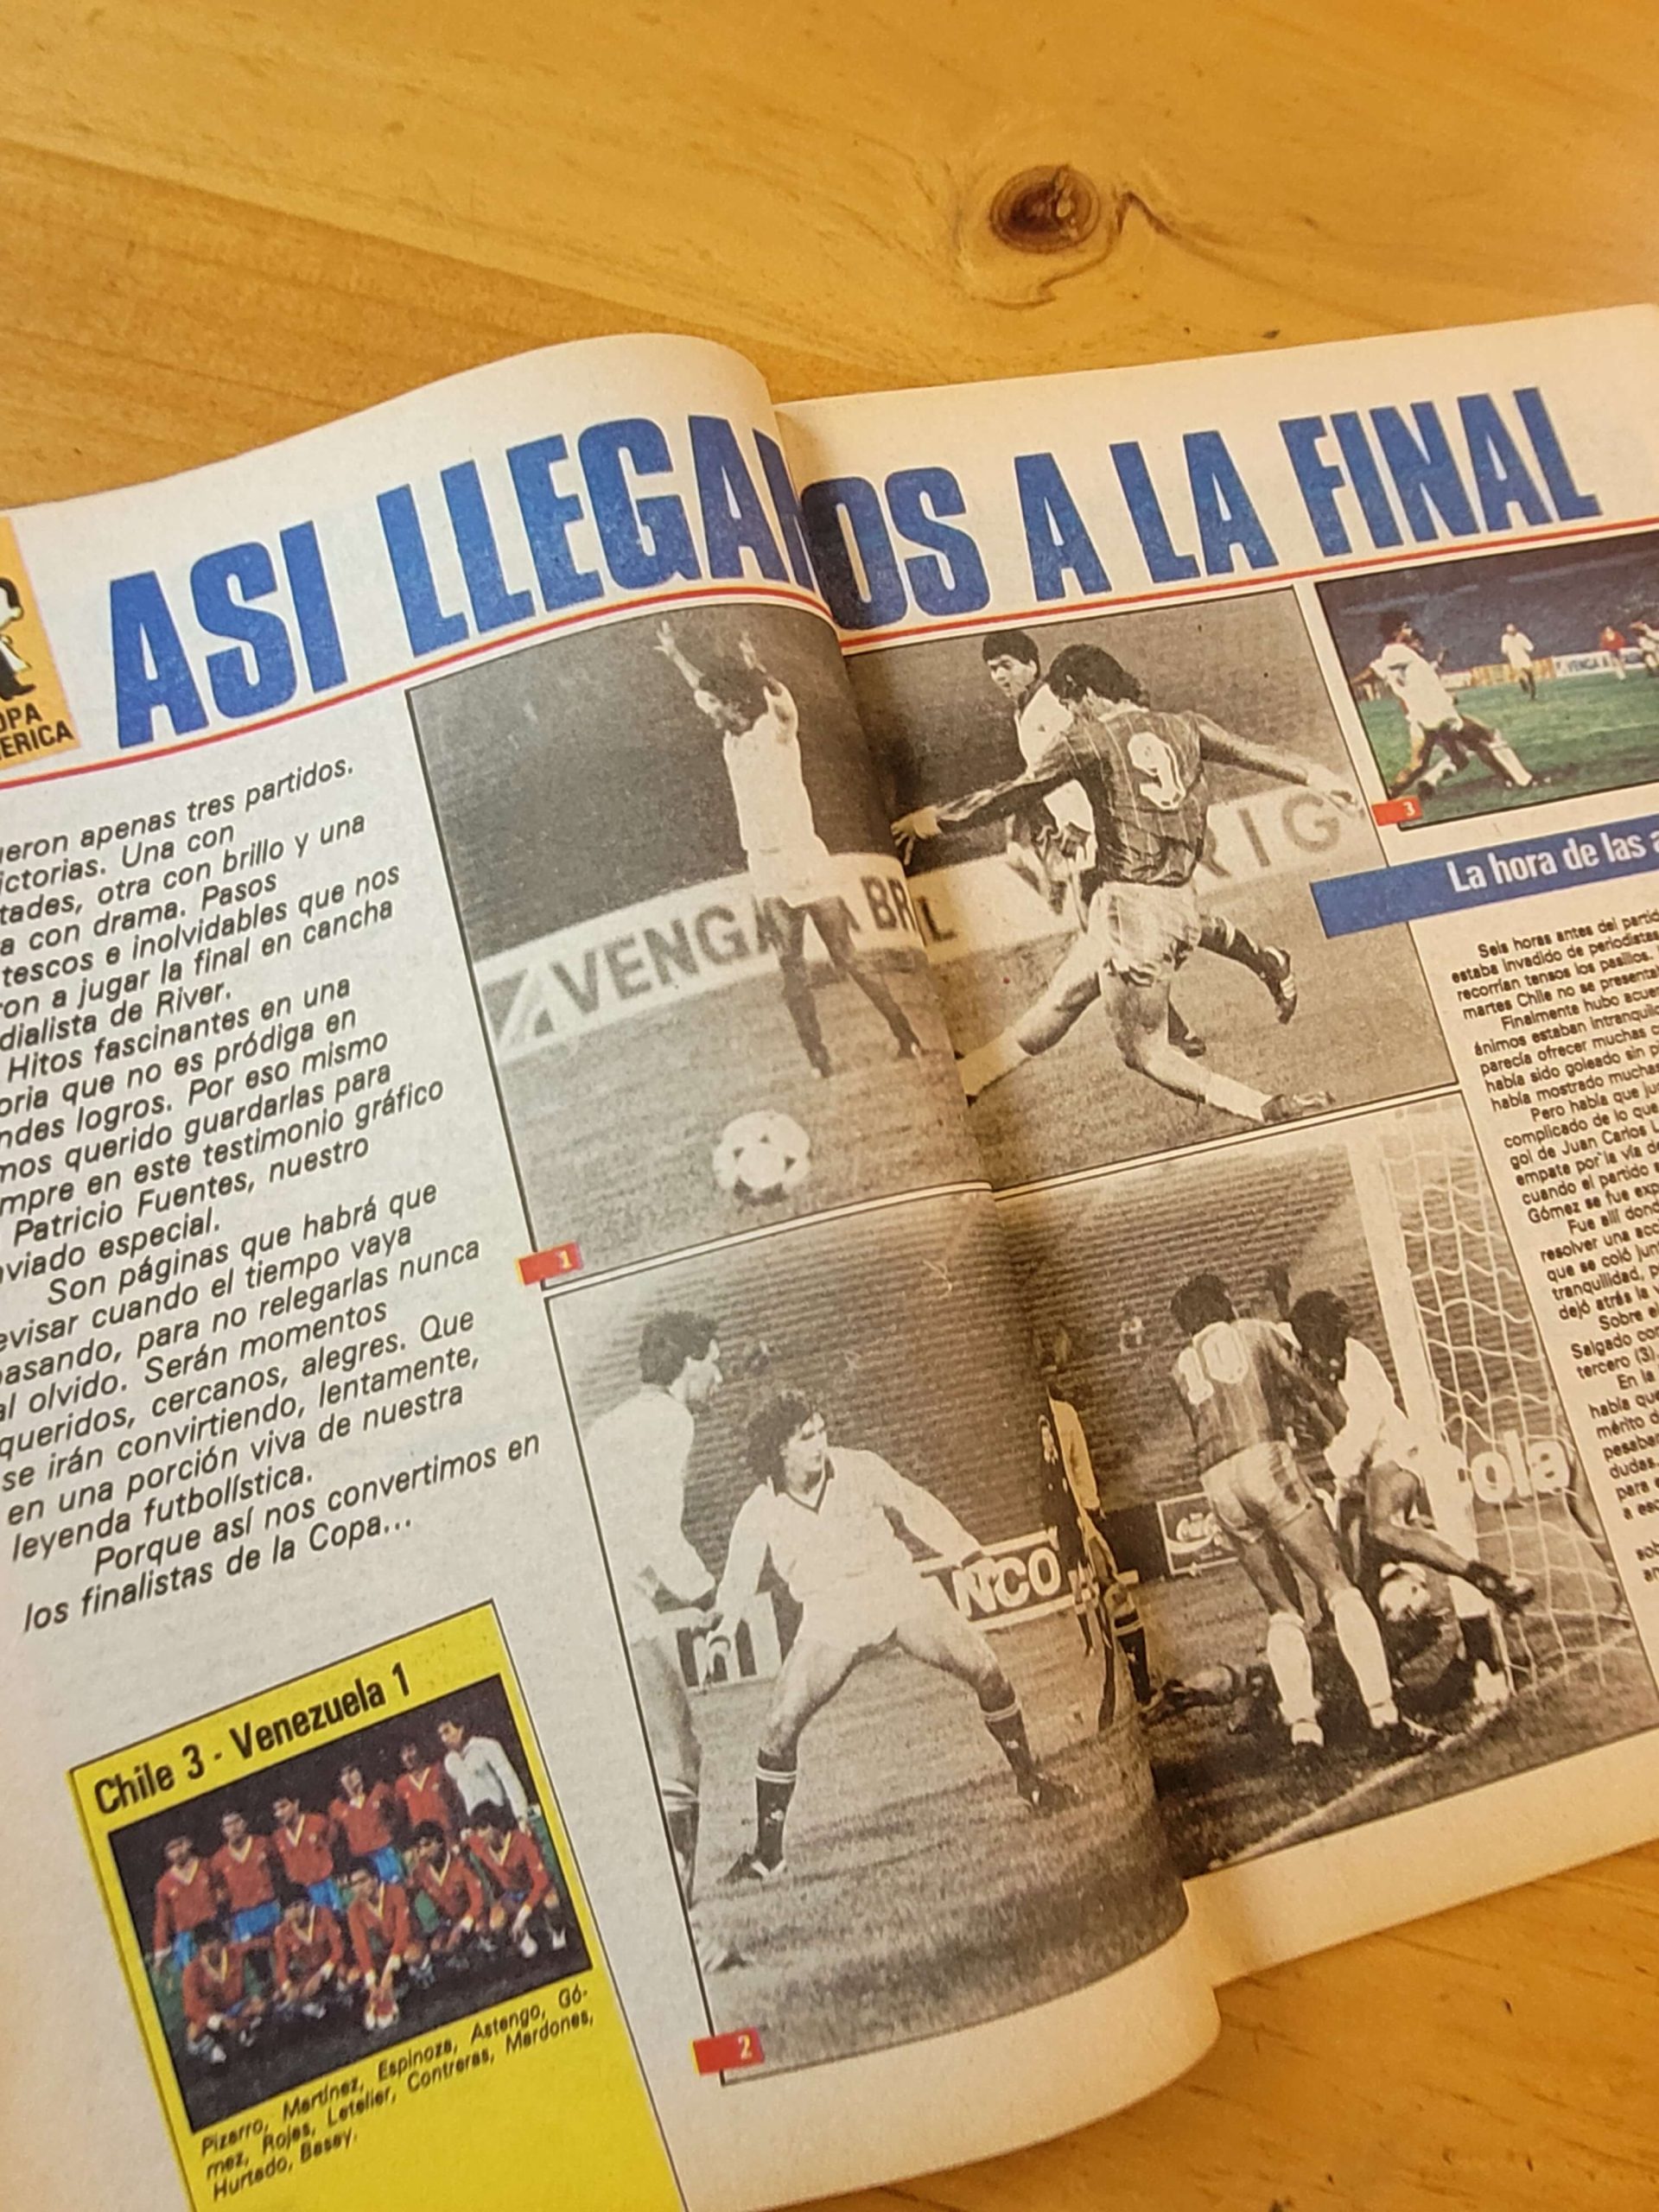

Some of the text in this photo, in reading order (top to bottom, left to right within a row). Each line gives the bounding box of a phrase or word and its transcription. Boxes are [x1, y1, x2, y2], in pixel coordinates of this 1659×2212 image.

[111, 519, 348, 749] ASI
[1014, 452, 1113, 601] A
[1109, 429, 1280, 583] LA
[1279, 386, 1604, 557] FINAL
[80, 759, 353, 850] apenas tres partidos.
[122, 824, 234, 868] Una con
[1403, 802, 1416, 817] 3
[98, 815, 365, 906] otra con brillo y una
[1446, 830, 1647, 892] La hora de las
[29, 874, 276, 950] con drama. Pasos
[105, 866, 399, 965] e inolvidables que nos
[1478, 917, 1618, 958] Seis horas antes del
[110, 982, 231, 1027] de River.
[1452, 963, 1499, 983] estaba
[1502, 949, 1563, 973] invadido
[1567, 944, 1585, 958] de
[1462, 982, 1596, 1020] martes Chile no se
[1523, 968, 1572, 987] tensos
[1573, 962, 1596, 976] los
[7, 978, 350, 1084] Hitos fascinantes en una
[62, 1009, 356, 1107] que no es pródiga en
[1474, 1022, 1587, 1056] ánimos estaban
[1484, 1046, 1646, 1093] había sido goleado sin
[76, 1032, 388, 1134] logros. Por eso mismo
[1530, 1088, 1640, 1122] Pero había que
[87, 1080, 443, 1195] en este testimonio gráfico
[1510, 1125, 1648, 1171] gol de Juan Carlos
[13, 1137, 369, 1248] Patricio Fuentes, nuestro
[1522, 1164, 1649, 1205] cuando el partido
[47, 1184, 436, 1306] Son páginas que habrá que
[92, 1226, 411, 1329] cuando el tiempo vaya
[99, 1206, 219, 1260] especial.
[558, 1252, 573, 1269] 1
[137, 1240, 479, 1359] para no relegarlas nunca
[152, 1312, 474, 1417] cercanos, alegres. Que
[1571, 1332, 1632, 1360] Salgado
[2, 1347, 479, 1492] se irán convirtiendo, lentamente,
[8, 1385, 462, 1526] en una porción viva de nuestra
[12, 1462, 320, 1562] leyenda futbolística.
[94, 1434, 539, 1577] Porque así nos convertimos en
[23, 1515, 411, 1634] los finalistas de la Copa...
[94, 1762, 175, 1817] Chile
[181, 1744, 206, 1781] 3
[228, 1677, 386, 1760] Venezuela
[391, 1662, 410, 1697] 1
[201, 2113, 269, 2159] Pizarro,
[378, 2038, 458, 2082] Espinoza,
[470, 2004, 546, 2046] Astengo,
[738, 2034, 753, 2060] 2
[207, 2010, 594, 2182] mez, Rojas, Letelier, Contreras, Mardones,
[213, 2156, 294, 2203] Hurtado,
